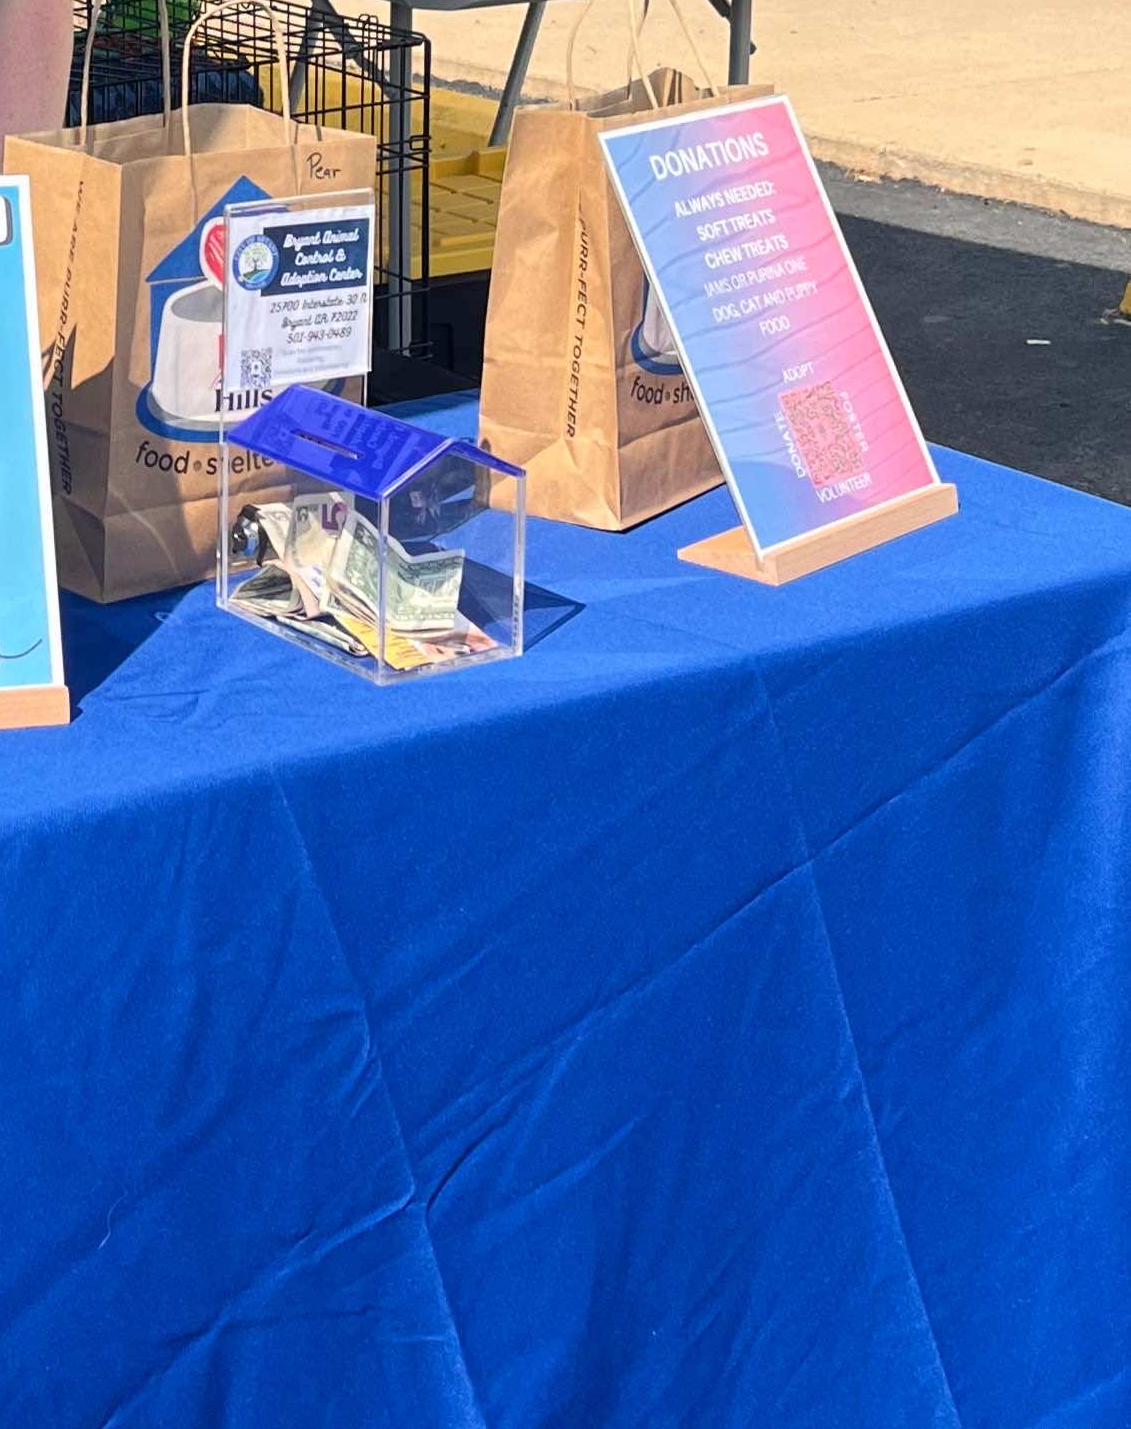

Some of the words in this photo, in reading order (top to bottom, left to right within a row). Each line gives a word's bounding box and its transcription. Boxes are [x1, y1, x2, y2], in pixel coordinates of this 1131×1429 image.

[649, 132, 769, 180] DONATIONS
[674, 192, 724, 218] ALWAYS
[724, 180, 776, 206] NEEDED:
[283, 231, 321, 251] Bryant
[322, 228, 360, 244] Animal
[696, 219, 731, 241] SOFT
[729, 209, 777, 233] TREATS
[295, 250, 334, 266] Control
[704, 245, 743, 269] CHEW
[742, 234, 789, 259] TREATS
[281, 270, 328, 288] Adoption
[329, 267, 363, 282] Center
[730, 272, 749, 290] OR
[740, 295, 762, 314] CAT
[762, 289, 786, 308] AND
[51, 267, 73, 383] PURR-FECT
[758, 314, 790, 338] FOOD
[566, 334, 583, 438] TOGETHER
[782, 361, 815, 384] ADOPT
[630, 375, 665, 404] food
[52, 391, 71, 496] TOGETHER
[135, 441, 190, 475] food
[774, 410, 807, 479] DONATE
[816, 472, 873, 503] VOLUNTEER
